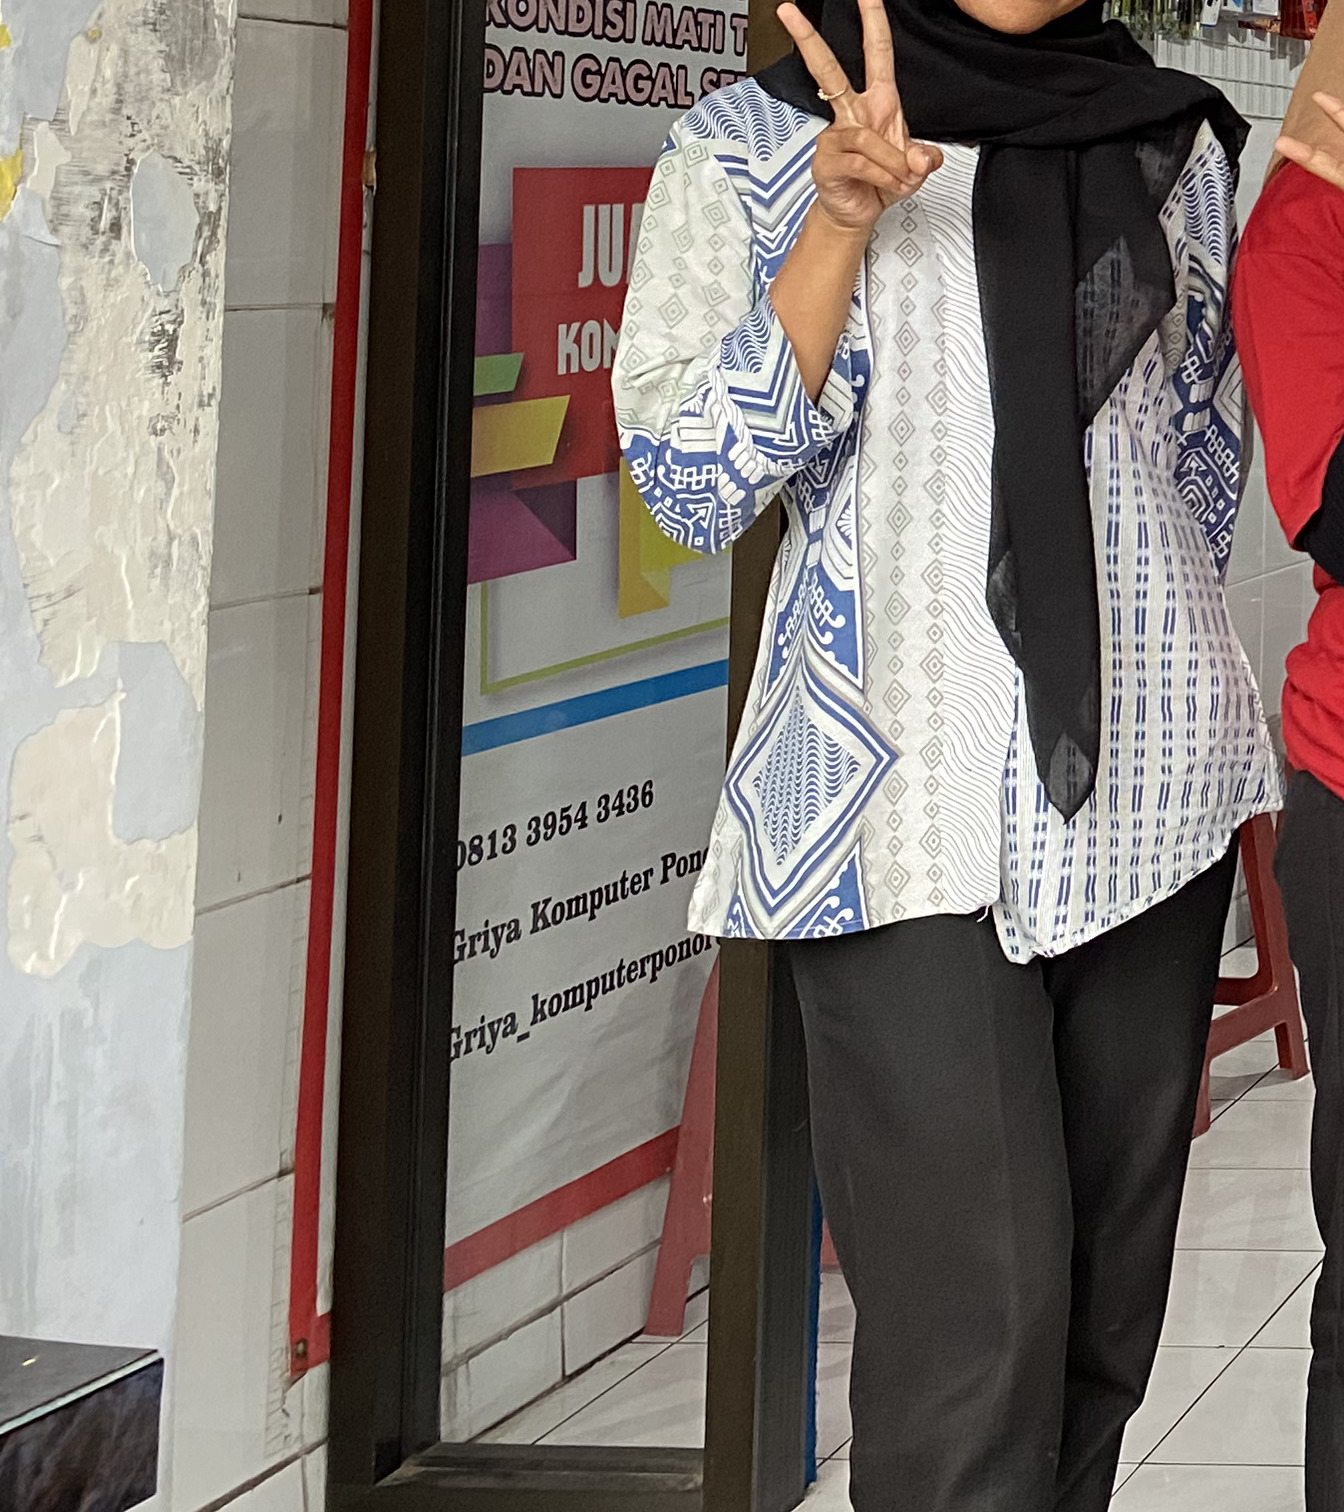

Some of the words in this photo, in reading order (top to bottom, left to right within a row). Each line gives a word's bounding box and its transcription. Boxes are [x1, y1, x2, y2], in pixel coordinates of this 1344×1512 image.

[643, 1, 725, 55] MATI
[483, 44, 564, 97] DAN
[572, 53, 694, 109] GAGAL
[527, 801, 588, 847] 3954
[597, 780, 654, 823] 3436
[452, 917, 521, 964] Griya
[530, 867, 654, 934] Komputer
